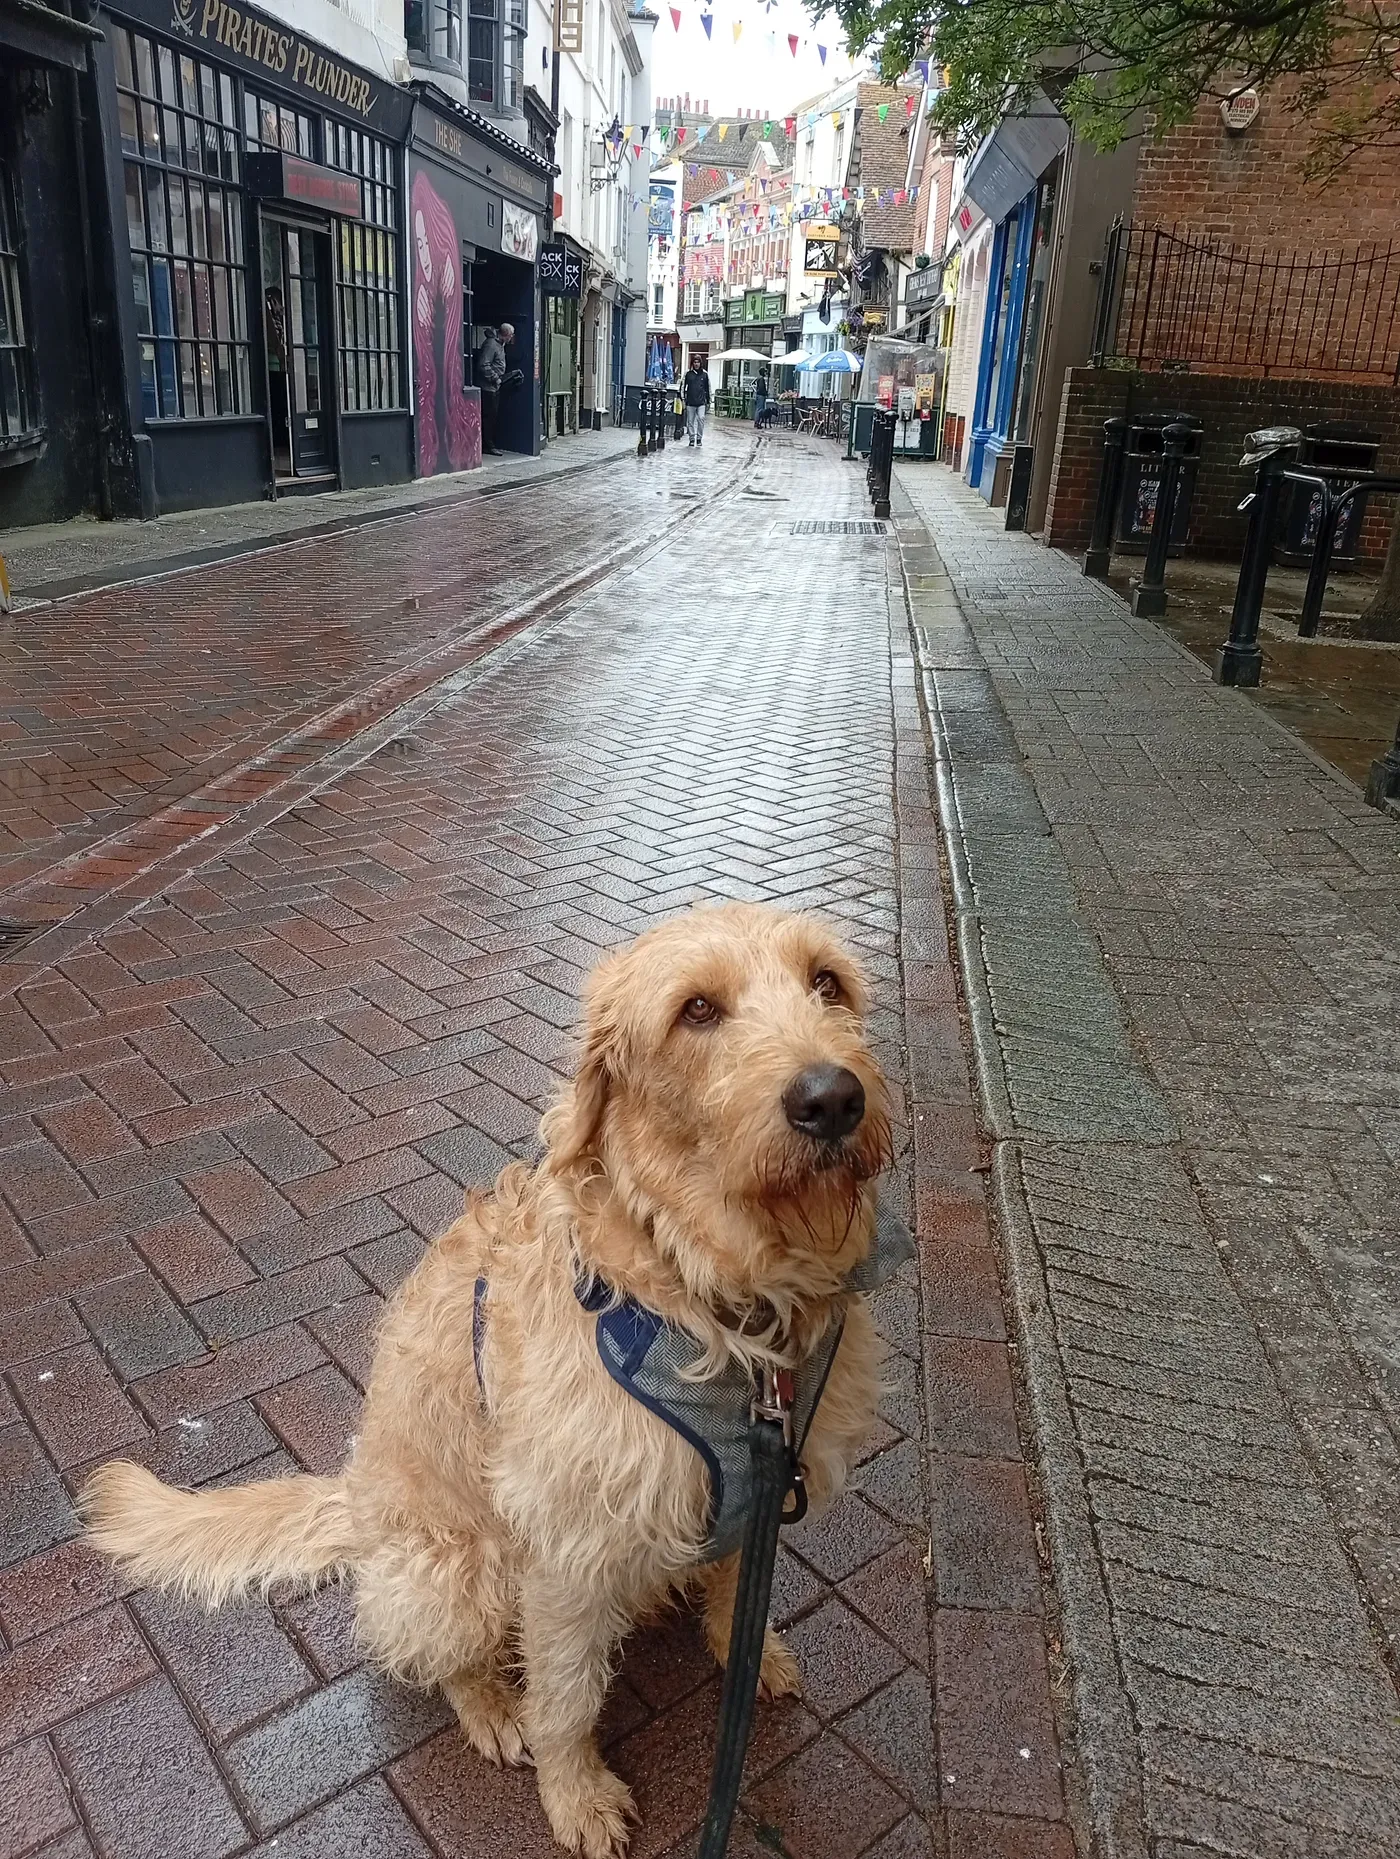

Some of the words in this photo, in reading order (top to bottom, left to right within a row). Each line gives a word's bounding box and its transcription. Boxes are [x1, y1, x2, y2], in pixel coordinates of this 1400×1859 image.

[200, 0, 294, 73] PIRATES'
[292, 42, 370, 111] PLUNDER
[435, 119, 448, 148] THE
[449, 128, 462, 156] SHE
[541, 252, 562, 262] ACK
[1140, 463, 1186, 475] LITR
